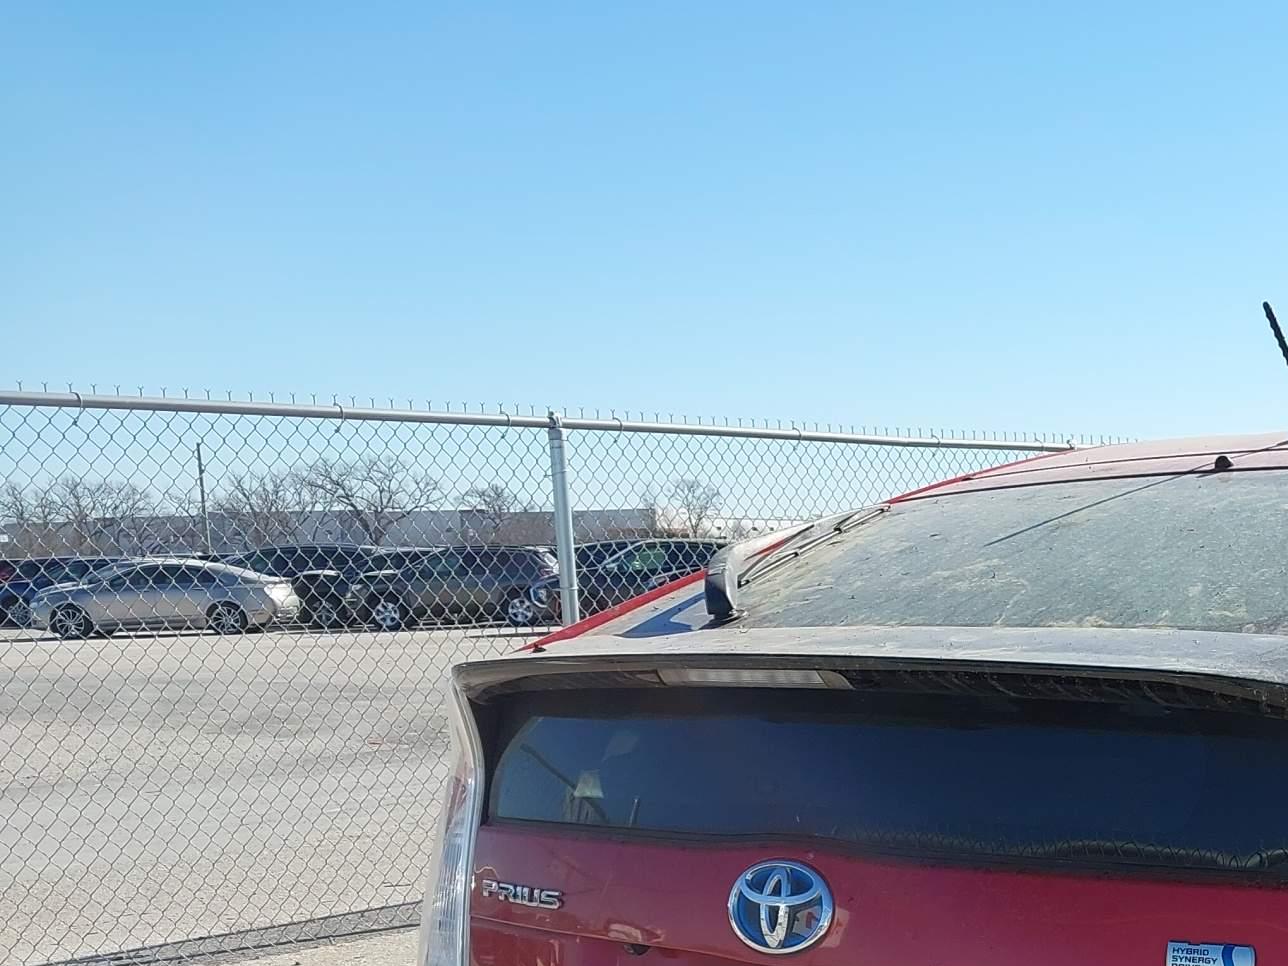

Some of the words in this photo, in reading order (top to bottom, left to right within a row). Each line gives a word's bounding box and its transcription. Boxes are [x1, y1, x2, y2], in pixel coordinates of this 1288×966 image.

[482, 880, 561, 909] PRIUS
[1172, 947, 1210, 956] HYBRID
[1171, 955, 1218, 965] SYNERGY
